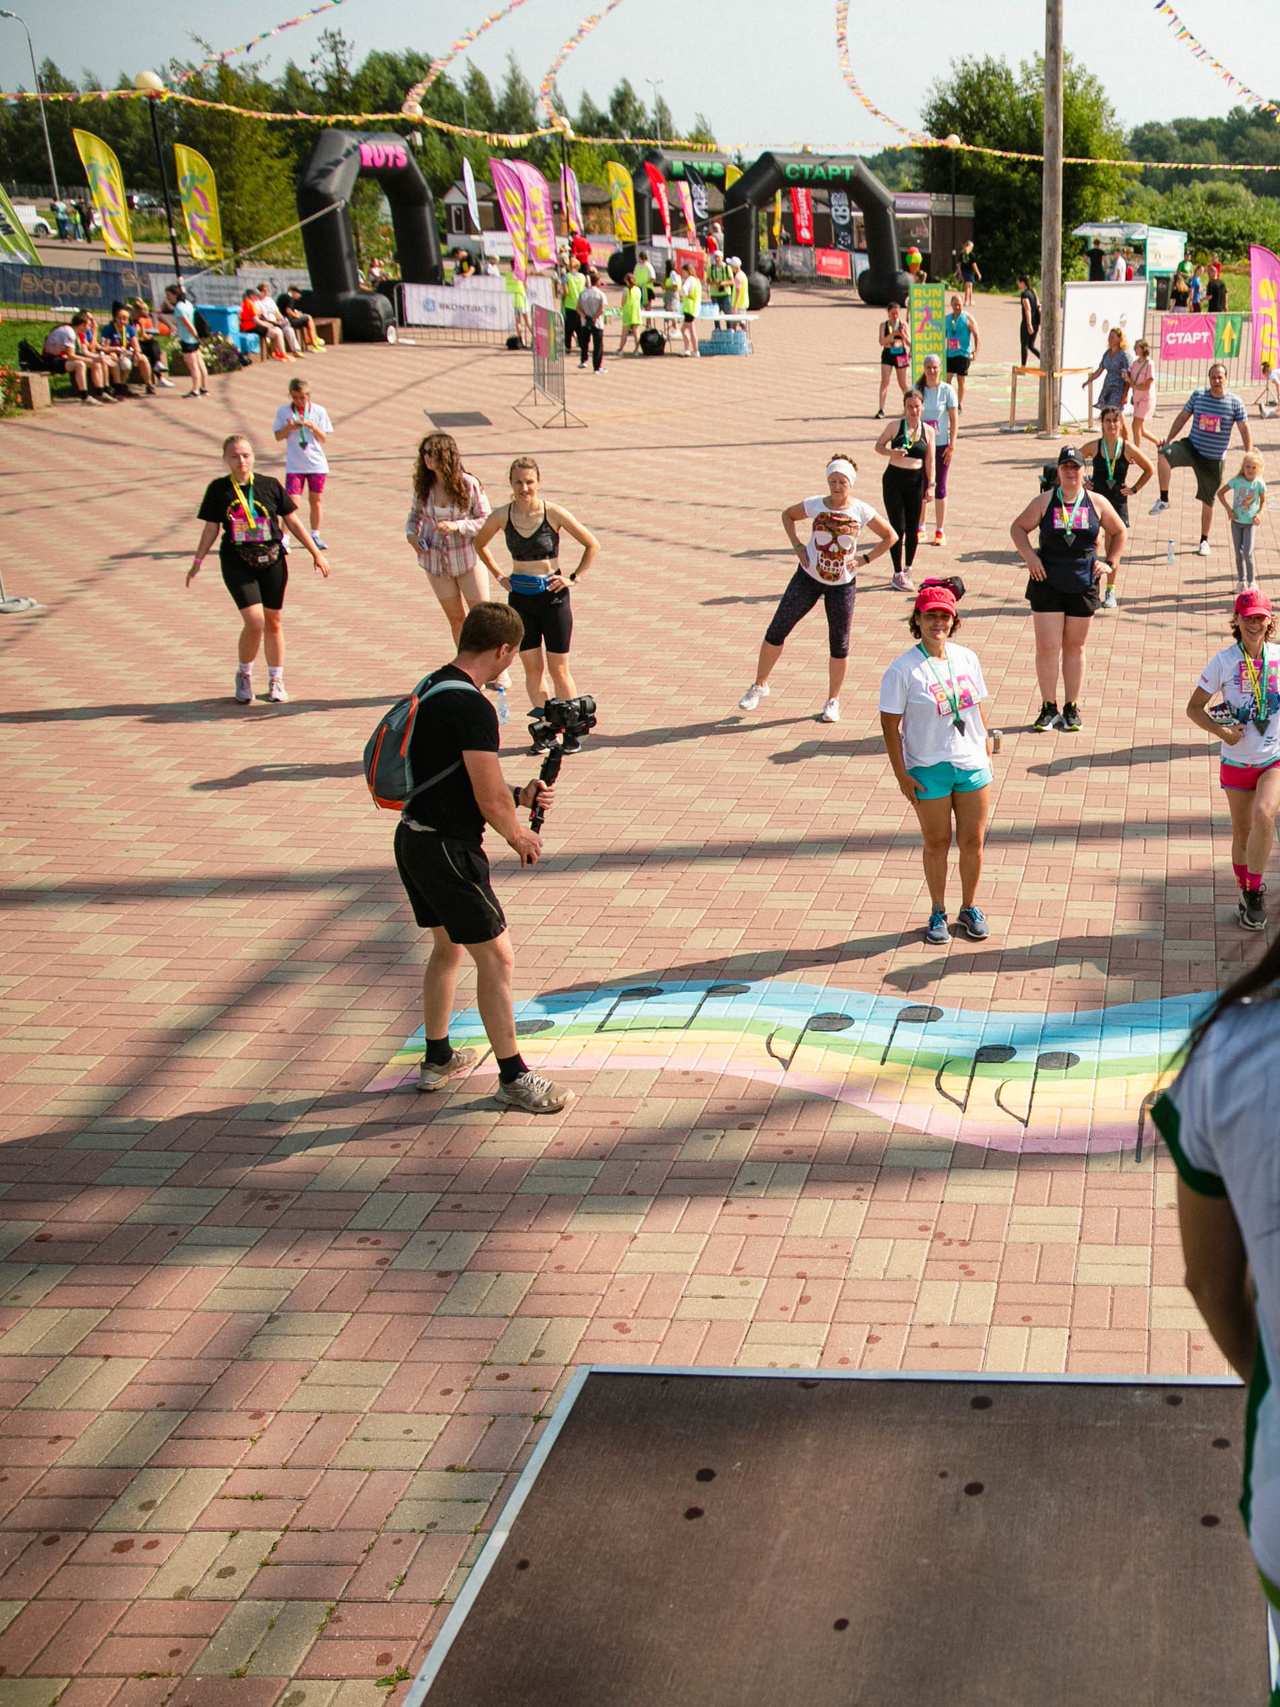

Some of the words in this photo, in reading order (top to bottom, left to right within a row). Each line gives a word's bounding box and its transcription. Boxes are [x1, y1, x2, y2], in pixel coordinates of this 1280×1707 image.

[359, 143, 408, 168] RUTS
[785, 163, 854, 181] СТАРТ
[913, 288, 942, 298] RUN
[914, 310, 942, 319] RN
[914, 332, 943, 341] RUN
[1165, 331, 1210, 345] СТАРТ
[915, 342, 943, 352] RUN
